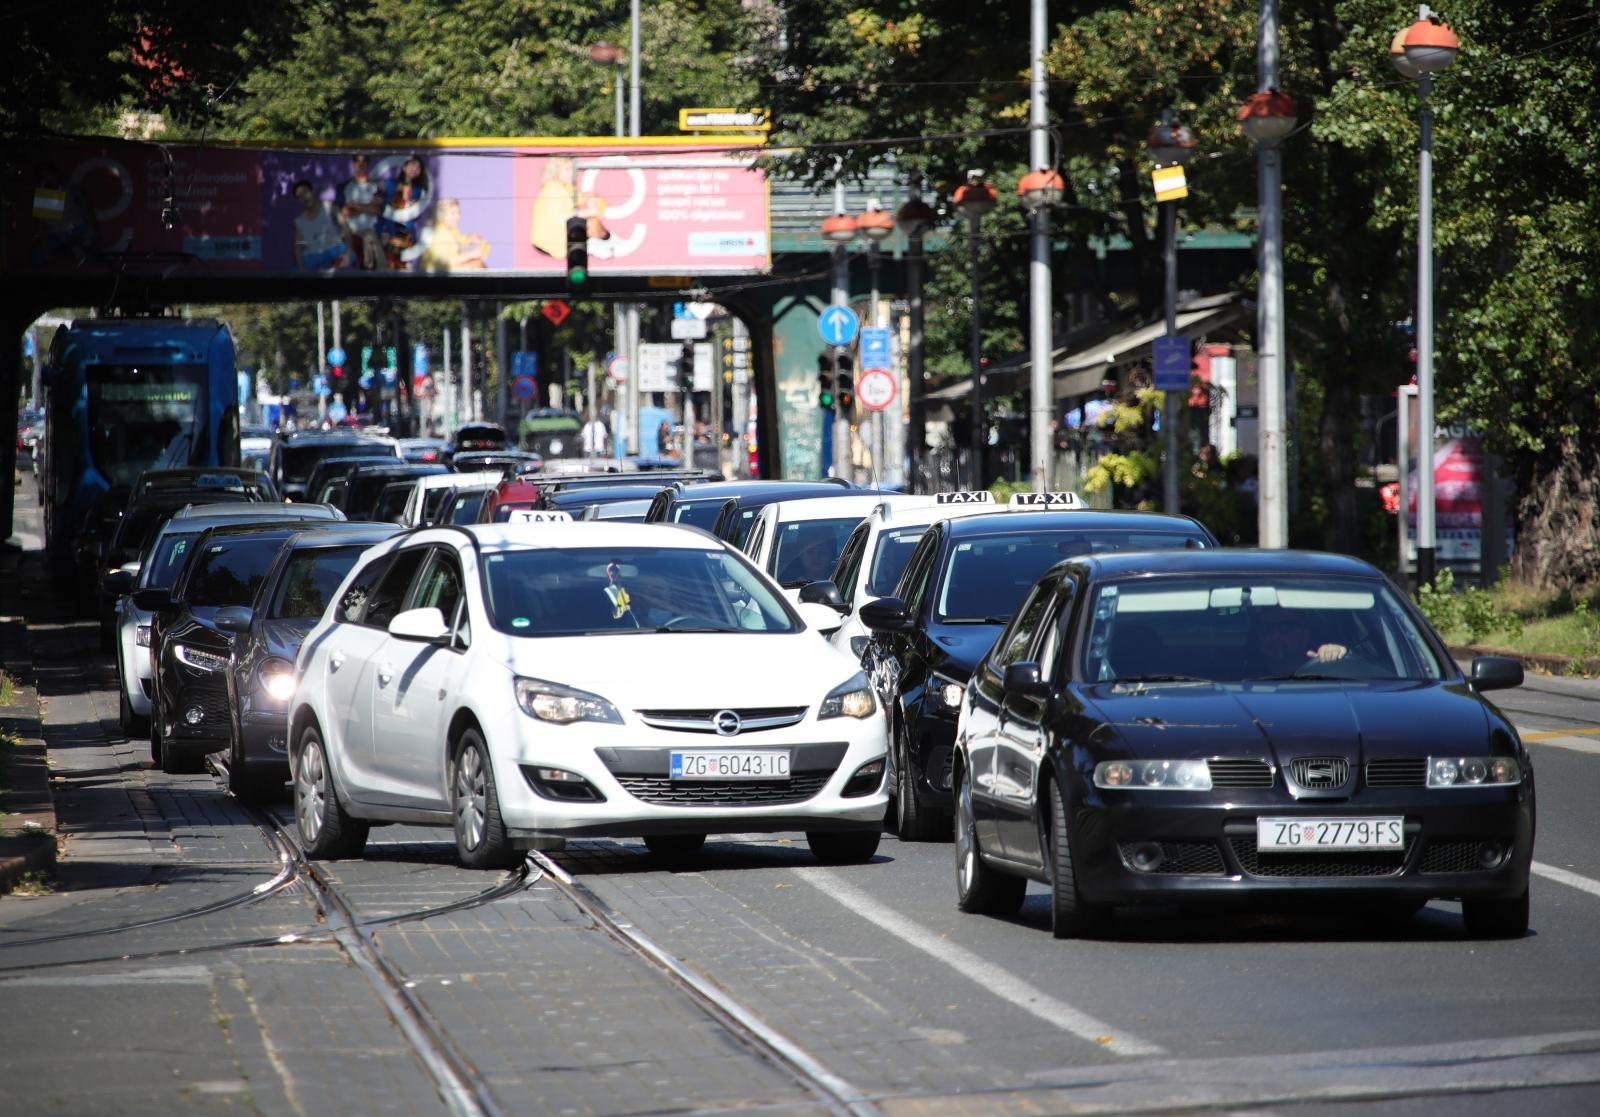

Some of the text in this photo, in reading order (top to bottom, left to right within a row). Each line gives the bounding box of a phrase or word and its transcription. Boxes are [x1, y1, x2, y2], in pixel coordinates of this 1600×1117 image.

[938, 492, 986, 503] TAXI
[1018, 493, 1071, 504] TAXI
[521, 513, 565, 522] TAXI
[685, 756, 706, 775] ZG
[1274, 823, 1301, 846] ZG
